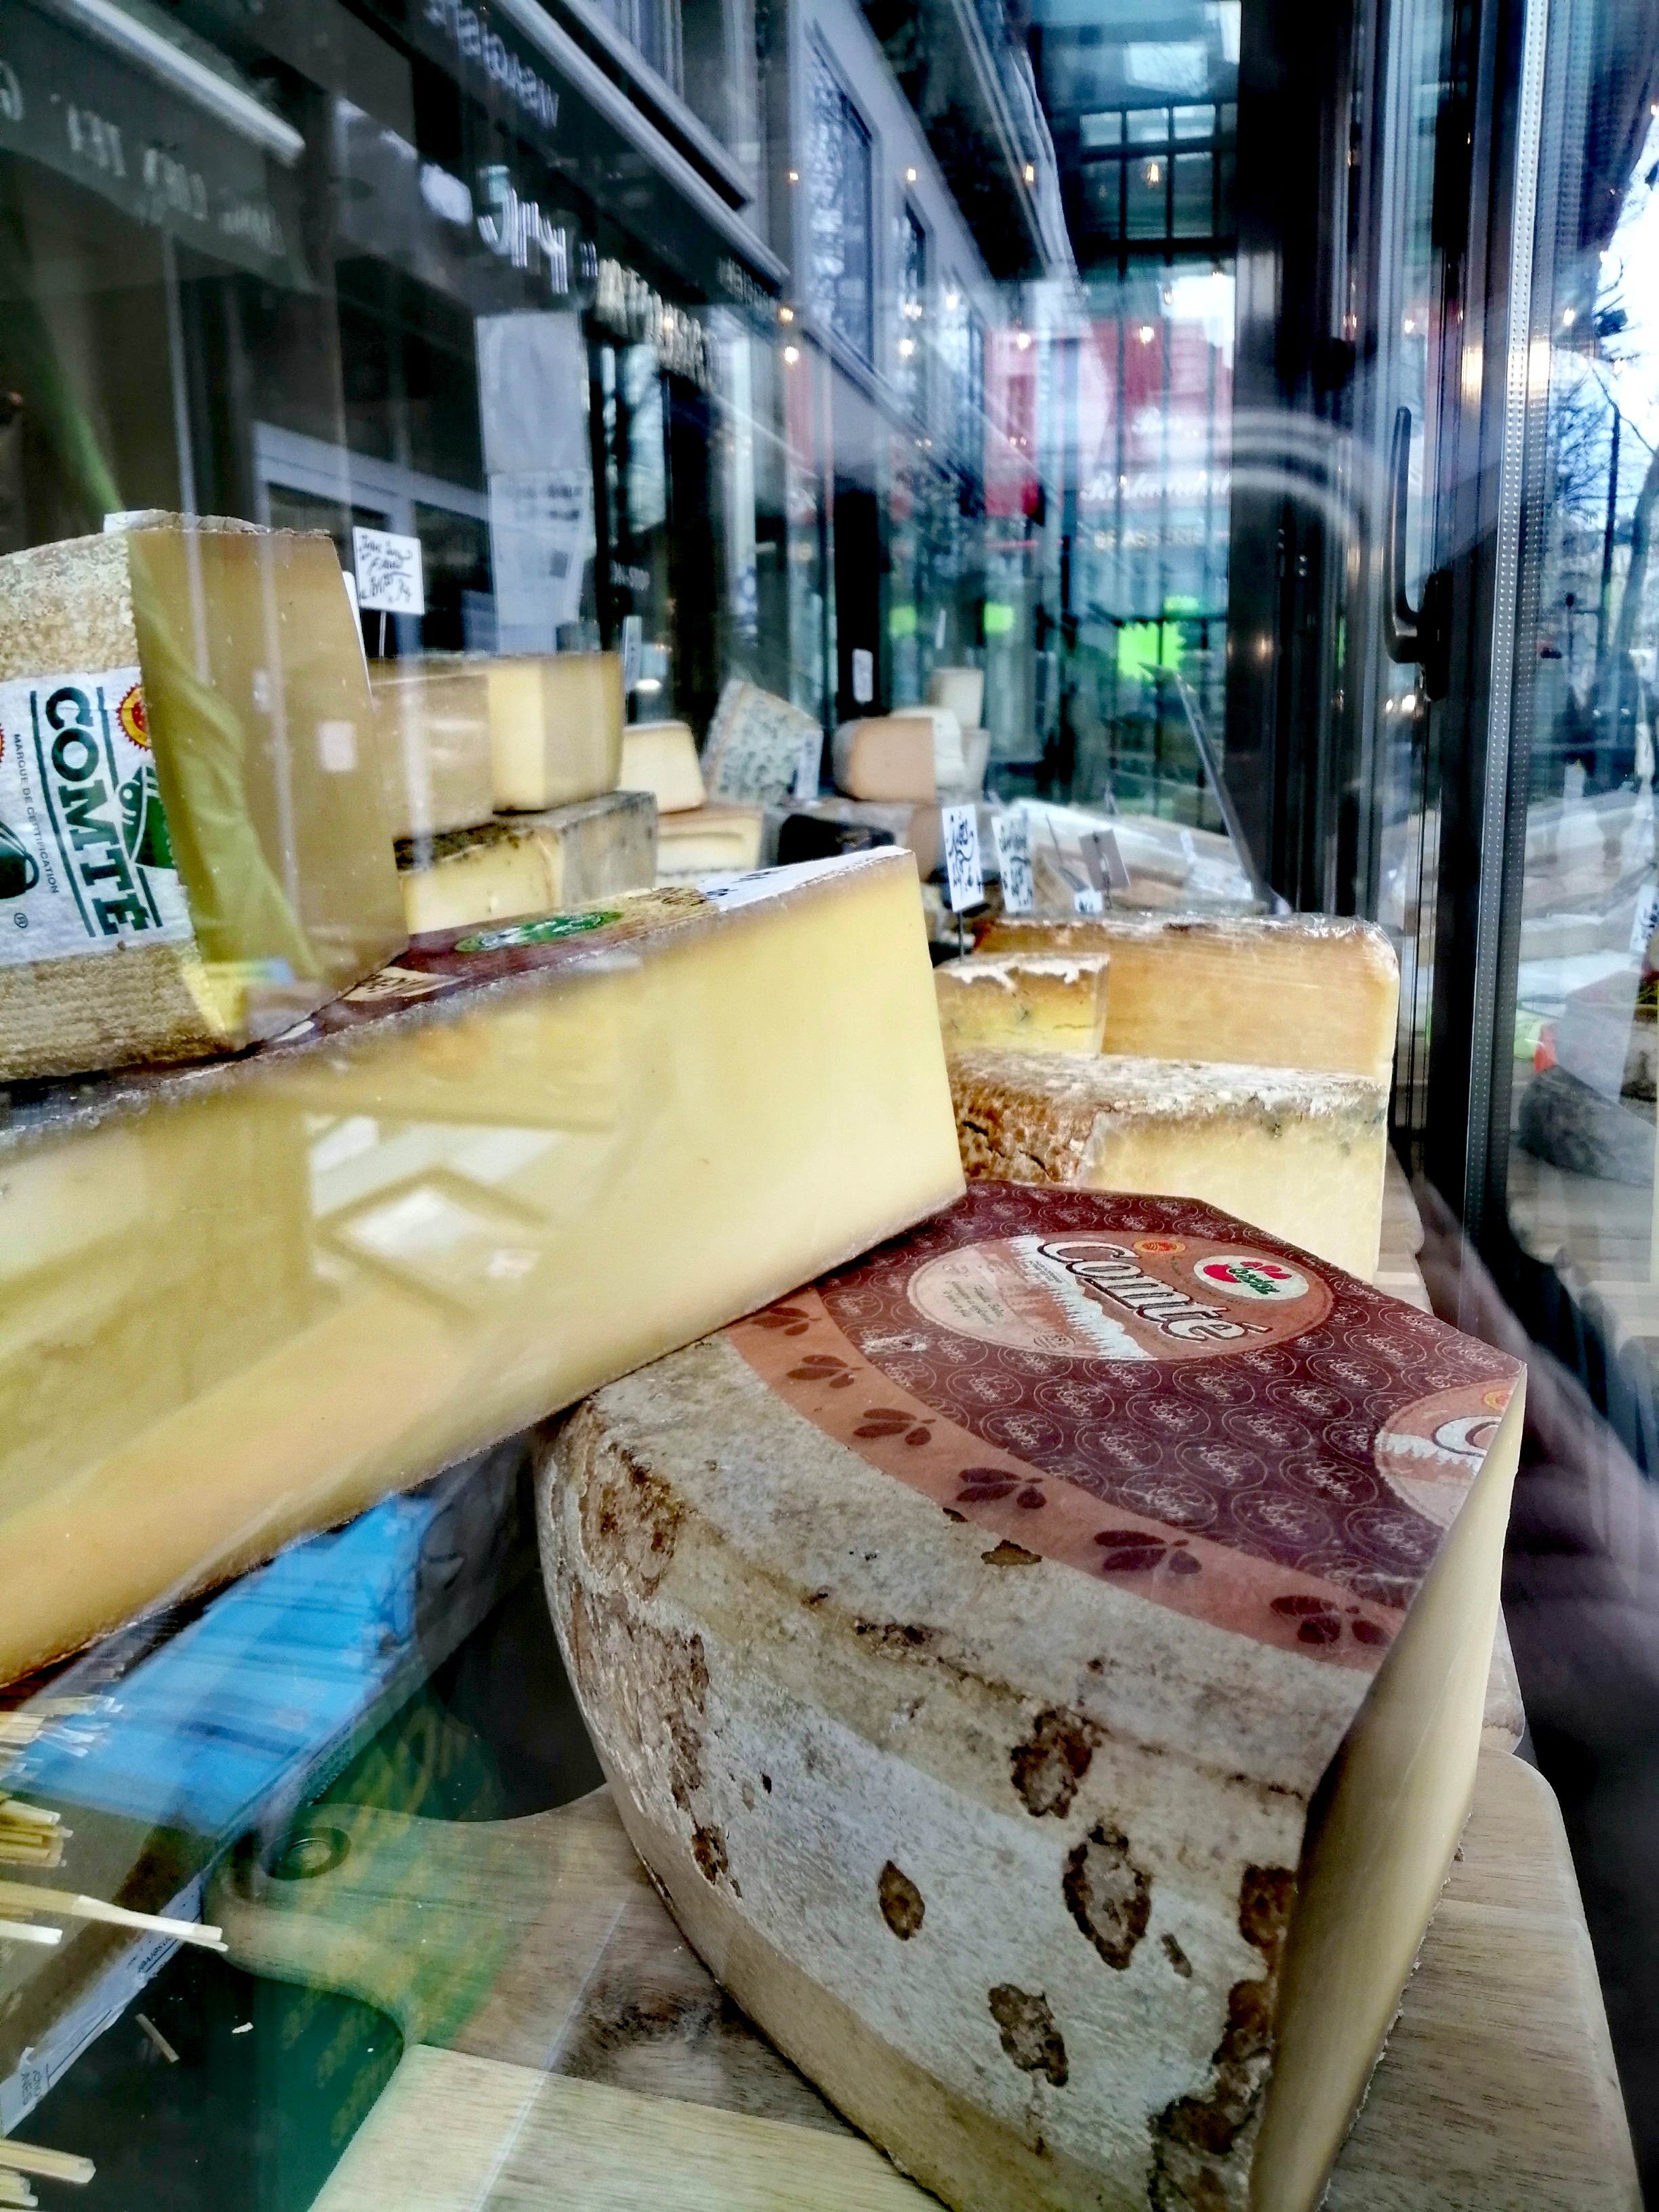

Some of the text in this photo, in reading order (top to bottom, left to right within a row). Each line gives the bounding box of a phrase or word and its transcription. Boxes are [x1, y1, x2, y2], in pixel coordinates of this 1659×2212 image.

[14, 733, 60, 894] MARQUE DE CERTIFICATION
[1036, 1240, 1273, 1342] Comté
